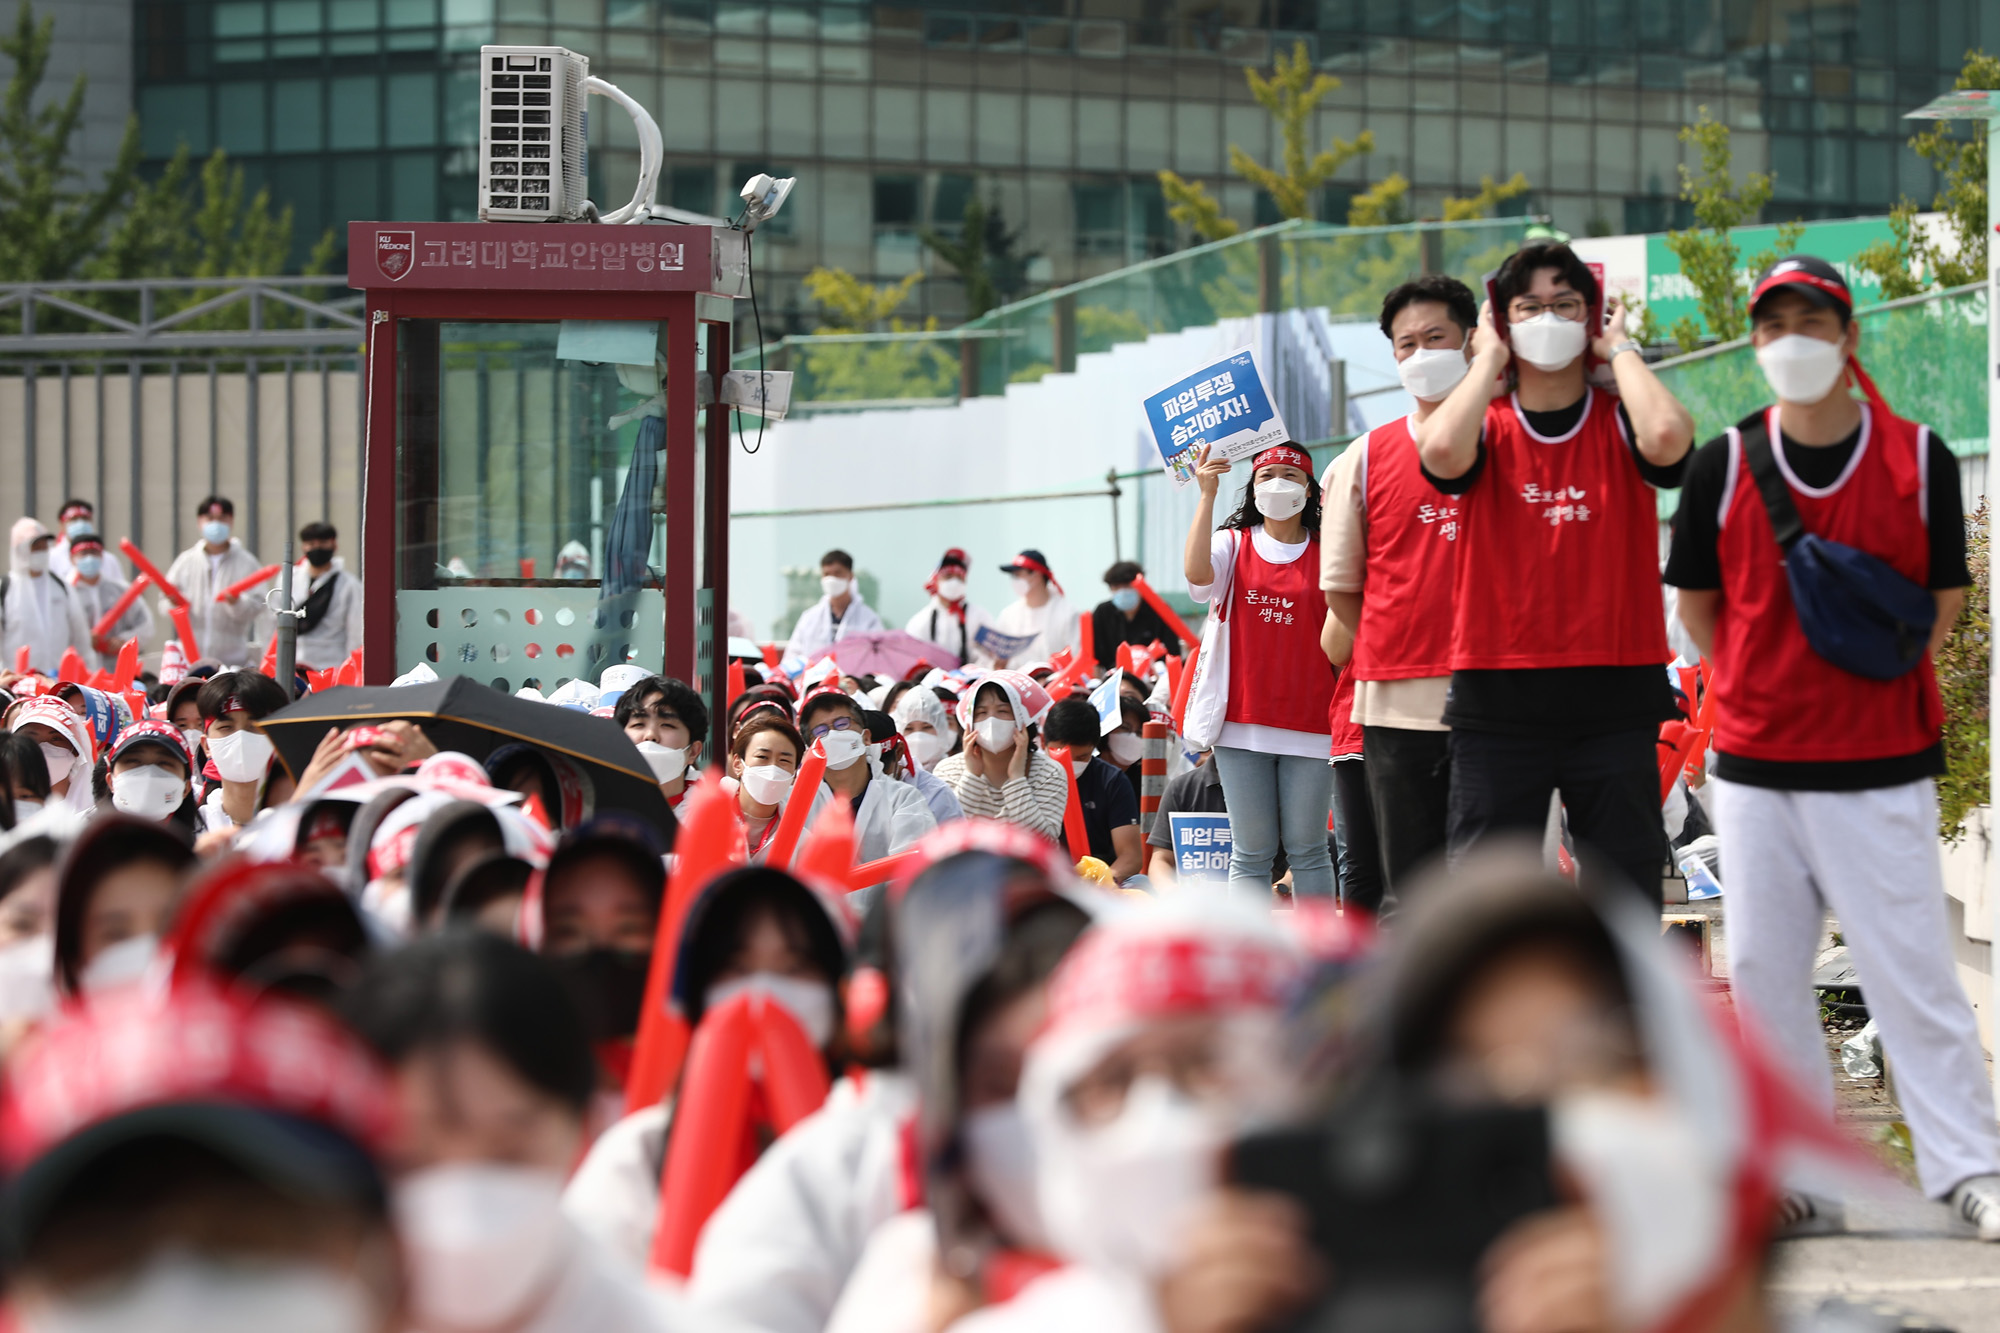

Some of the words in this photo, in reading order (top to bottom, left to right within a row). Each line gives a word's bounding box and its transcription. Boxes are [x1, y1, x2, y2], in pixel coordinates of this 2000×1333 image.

[379, 235, 391, 243] KU
[421, 240, 685, 273] 고려대학교안암병원
[1161, 371, 1236, 422] 파업투쟁
[1170, 393, 1252, 447] 승리하자!
[1521, 483, 1567, 503] 돈보다
[1542, 504, 1591, 526] 생명을
[1245, 590, 1281, 607] 돈보다
[1258, 608, 1295, 625] 생명을
